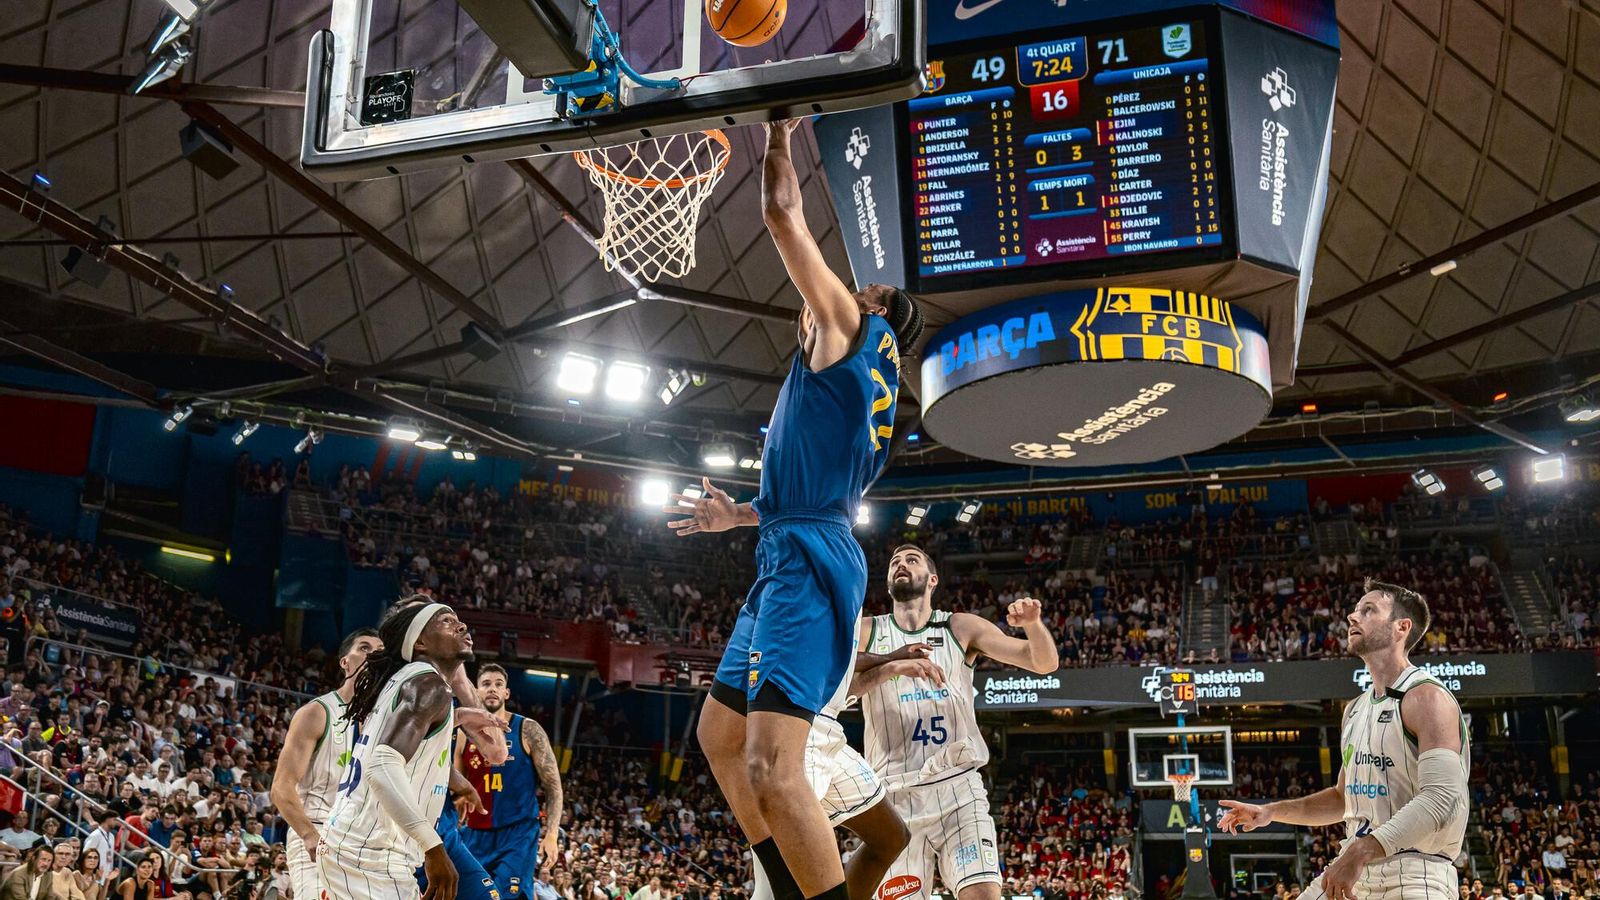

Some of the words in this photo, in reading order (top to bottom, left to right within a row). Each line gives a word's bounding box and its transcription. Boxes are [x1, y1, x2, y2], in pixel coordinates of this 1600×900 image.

[1027, 48, 1038, 58] 4t
[1040, 42, 1077, 56] QUART
[1097, 38, 1129, 65] 71
[971, 56, 1006, 82] 49
[1032, 56, 1073, 78] 7:24
[1133, 67, 1171, 79] UNICAJA
[945, 95, 973, 106] BARÇA
[1042, 89, 1069, 112] 16
[1106, 96, 1111, 105] 0
[1112, 92, 1140, 104] PÉREZ
[1185, 86, 1191, 94] 0
[1107, 109, 1113, 117] 2
[1113, 100, 1176, 116] BALCEROWSKI
[1199, 97, 1207, 105] 11
[917, 121, 923, 131] 0
[924, 118, 957, 130] PUNTER
[991, 112, 998, 121] 0
[1003, 110, 1013, 119] 10
[1114, 118, 1136, 129] EJIM
[1186, 111, 1193, 119] 0
[920, 134, 924, 142] 1
[925, 128, 969, 142] ANDERSON
[1006, 123, 1012, 131] 2
[1043, 133, 1073, 143] FALTES
[1115, 127, 1163, 141] KALINOSKI
[1188, 124, 1193, 132] 2
[926, 141, 966, 154] BRIZUELA
[993, 137, 999, 145] 3
[1006, 135, 1012, 143] 5
[1110, 146, 1115, 155] 6
[1116, 142, 1149, 154] TAYLOR
[1188, 136, 1195, 144] 0
[1203, 135, 1209, 143] 2
[926, 152, 979, 166] SATORANSKY
[994, 149, 1000, 157] 2
[1008, 147, 1013, 156] 2
[1035, 150, 1047, 165] 0
[1071, 145, 1083, 160] 3
[1111, 159, 1116, 167] 7
[1117, 154, 1162, 167] BARREIRO
[1204, 147, 1210, 156] 0
[1260, 118, 1276, 191] Sanitària
[927, 162, 990, 178] HERNANGÓMEZ
[995, 161, 1000, 169] 1
[1008, 160, 1014, 168] 5
[1111, 171, 1117, 180] 9
[1118, 168, 1139, 179] DÍAZ
[1190, 162, 1197, 171] 0
[1205, 160, 1211, 169] 0
[1272, 121, 1290, 226] Assistència
[919, 183, 927, 191] 19
[928, 181, 948, 190] FALL
[996, 174, 1001, 182] 2
[1009, 172, 1015, 180] 9
[1034, 179, 1062, 191] TEMPS
[1064, 177, 1087, 188] MORT
[1110, 184, 1118, 192] 11
[1118, 179, 1152, 191] CARTER
[1192, 175, 1197, 183] 2
[1193, 187, 1198, 195] 2
[1207, 185, 1213, 194] 7
[920, 195, 929, 203] 21
[929, 190, 965, 203] ABRINES
[997, 186, 1001, 194] 1
[1010, 184, 1016, 193] 0
[1040, 195, 1049, 210] 1
[1076, 191, 1085, 206] 1
[852, 180, 871, 248] Sanitària
[919, 207, 929, 216] 22
[929, 203, 962, 215] PARKER
[998, 198, 1003, 206] 1
[1010, 196, 1016, 204] 7
[1120, 205, 1148, 217] TILLIE
[1193, 199, 1200, 208] 0
[1208, 198, 1214, 206] 5
[862, 175, 885, 270] Assistència
[920, 219, 930, 227] 41
[930, 216, 955, 227] KEITA
[998, 210, 1005, 218] 0
[1011, 208, 1018, 217] 0
[1110, 222, 1121, 230] 45
[1121, 217, 1160, 229] KRAVISH
[1195, 212, 1200, 221] 1
[1209, 211, 1215, 219] 2
[920, 231, 930, 239] 44
[931, 228, 959, 239] PARRA
[1012, 221, 1018, 229] 9
[1122, 231, 1152, 242] PERRY
[921, 243, 931, 252] 45
[932, 240, 961, 251] VILLAR
[1000, 235, 1006, 243] 0
[1013, 233, 1019, 241] 0
[1144, 240, 1178, 250] NAVARRO
[1196, 237, 1203, 245] 0
[922, 255, 932, 264] 47
[932, 250, 975, 263] GONZÁLEZ
[1000, 247, 1007, 255] 0
[1014, 245, 1020, 254] 0
[934, 264, 952, 273] JOAN
[953, 260, 994, 271] PEÑARROYA
[1002, 258, 1007, 266] 1
[939, 311, 1056, 377] BARÇA
[1057, 382, 1176, 442] Assistència
[1081, 407, 1169, 444] Sanitària
[1145, 493, 1177, 509] SOM
[985, 675, 1060, 690] Assistència
[1194, 668, 1264, 684] ssistència
[901, 687, 949, 702] málaga
[985, 690, 1038, 704] Sanitària
[1178, 685, 1194, 701] 16
[912, 716, 947, 746] 45
[484, 773, 502, 793] 14
[1167, 804, 1187, 828] A
